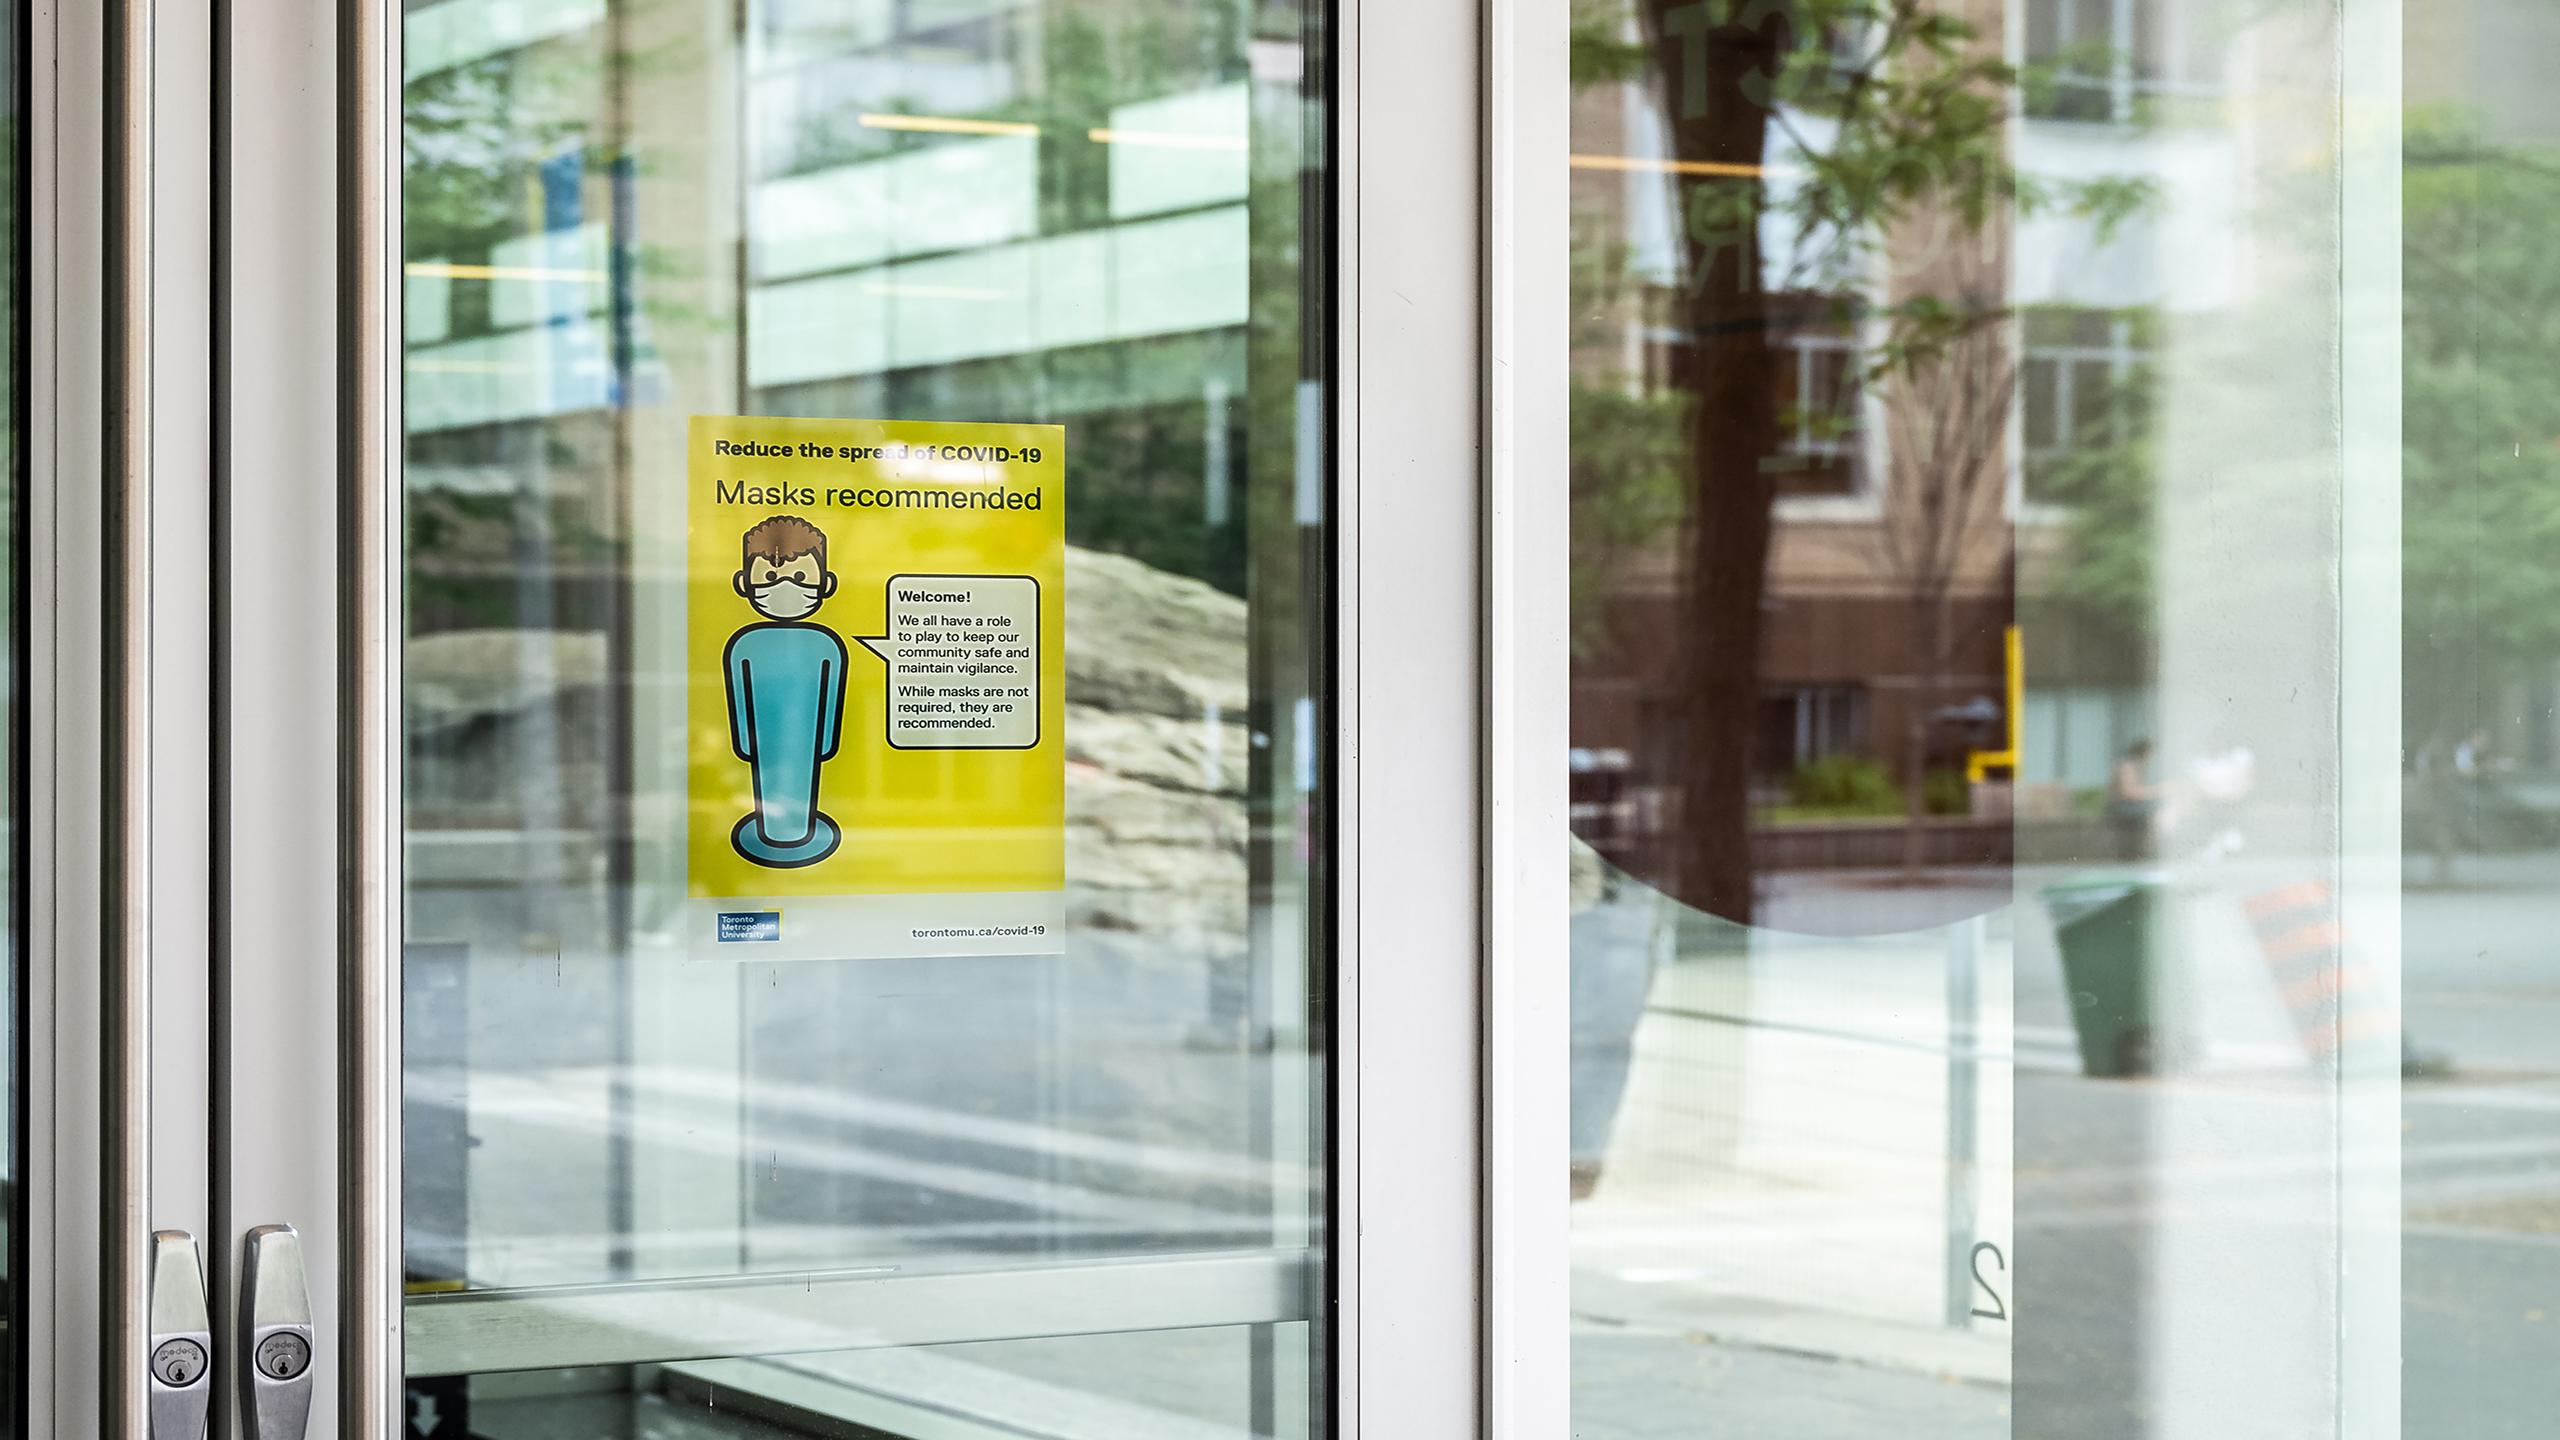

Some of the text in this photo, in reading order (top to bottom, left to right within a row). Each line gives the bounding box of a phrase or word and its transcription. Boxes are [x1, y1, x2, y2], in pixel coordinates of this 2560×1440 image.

[715, 440, 1042, 463] Reduce the spread of COVID-19
[716, 480, 1042, 511] Masks recommended
[898, 590, 971, 603] Welcome!
[898, 615, 1012, 627] We all have a role
[898, 631, 1020, 643] to play to keep our
[898, 647, 1030, 660] community safe and
[898, 663, 1018, 676] maintain vigilance.
[898, 686, 1029, 697] While masks are not
[898, 702, 1013, 715] required, they are
[898, 718, 996, 729] recommended.
[721, 923, 776, 931] Metropolitan
[912, 926, 1045, 937] torontomu.ca/covid-19
